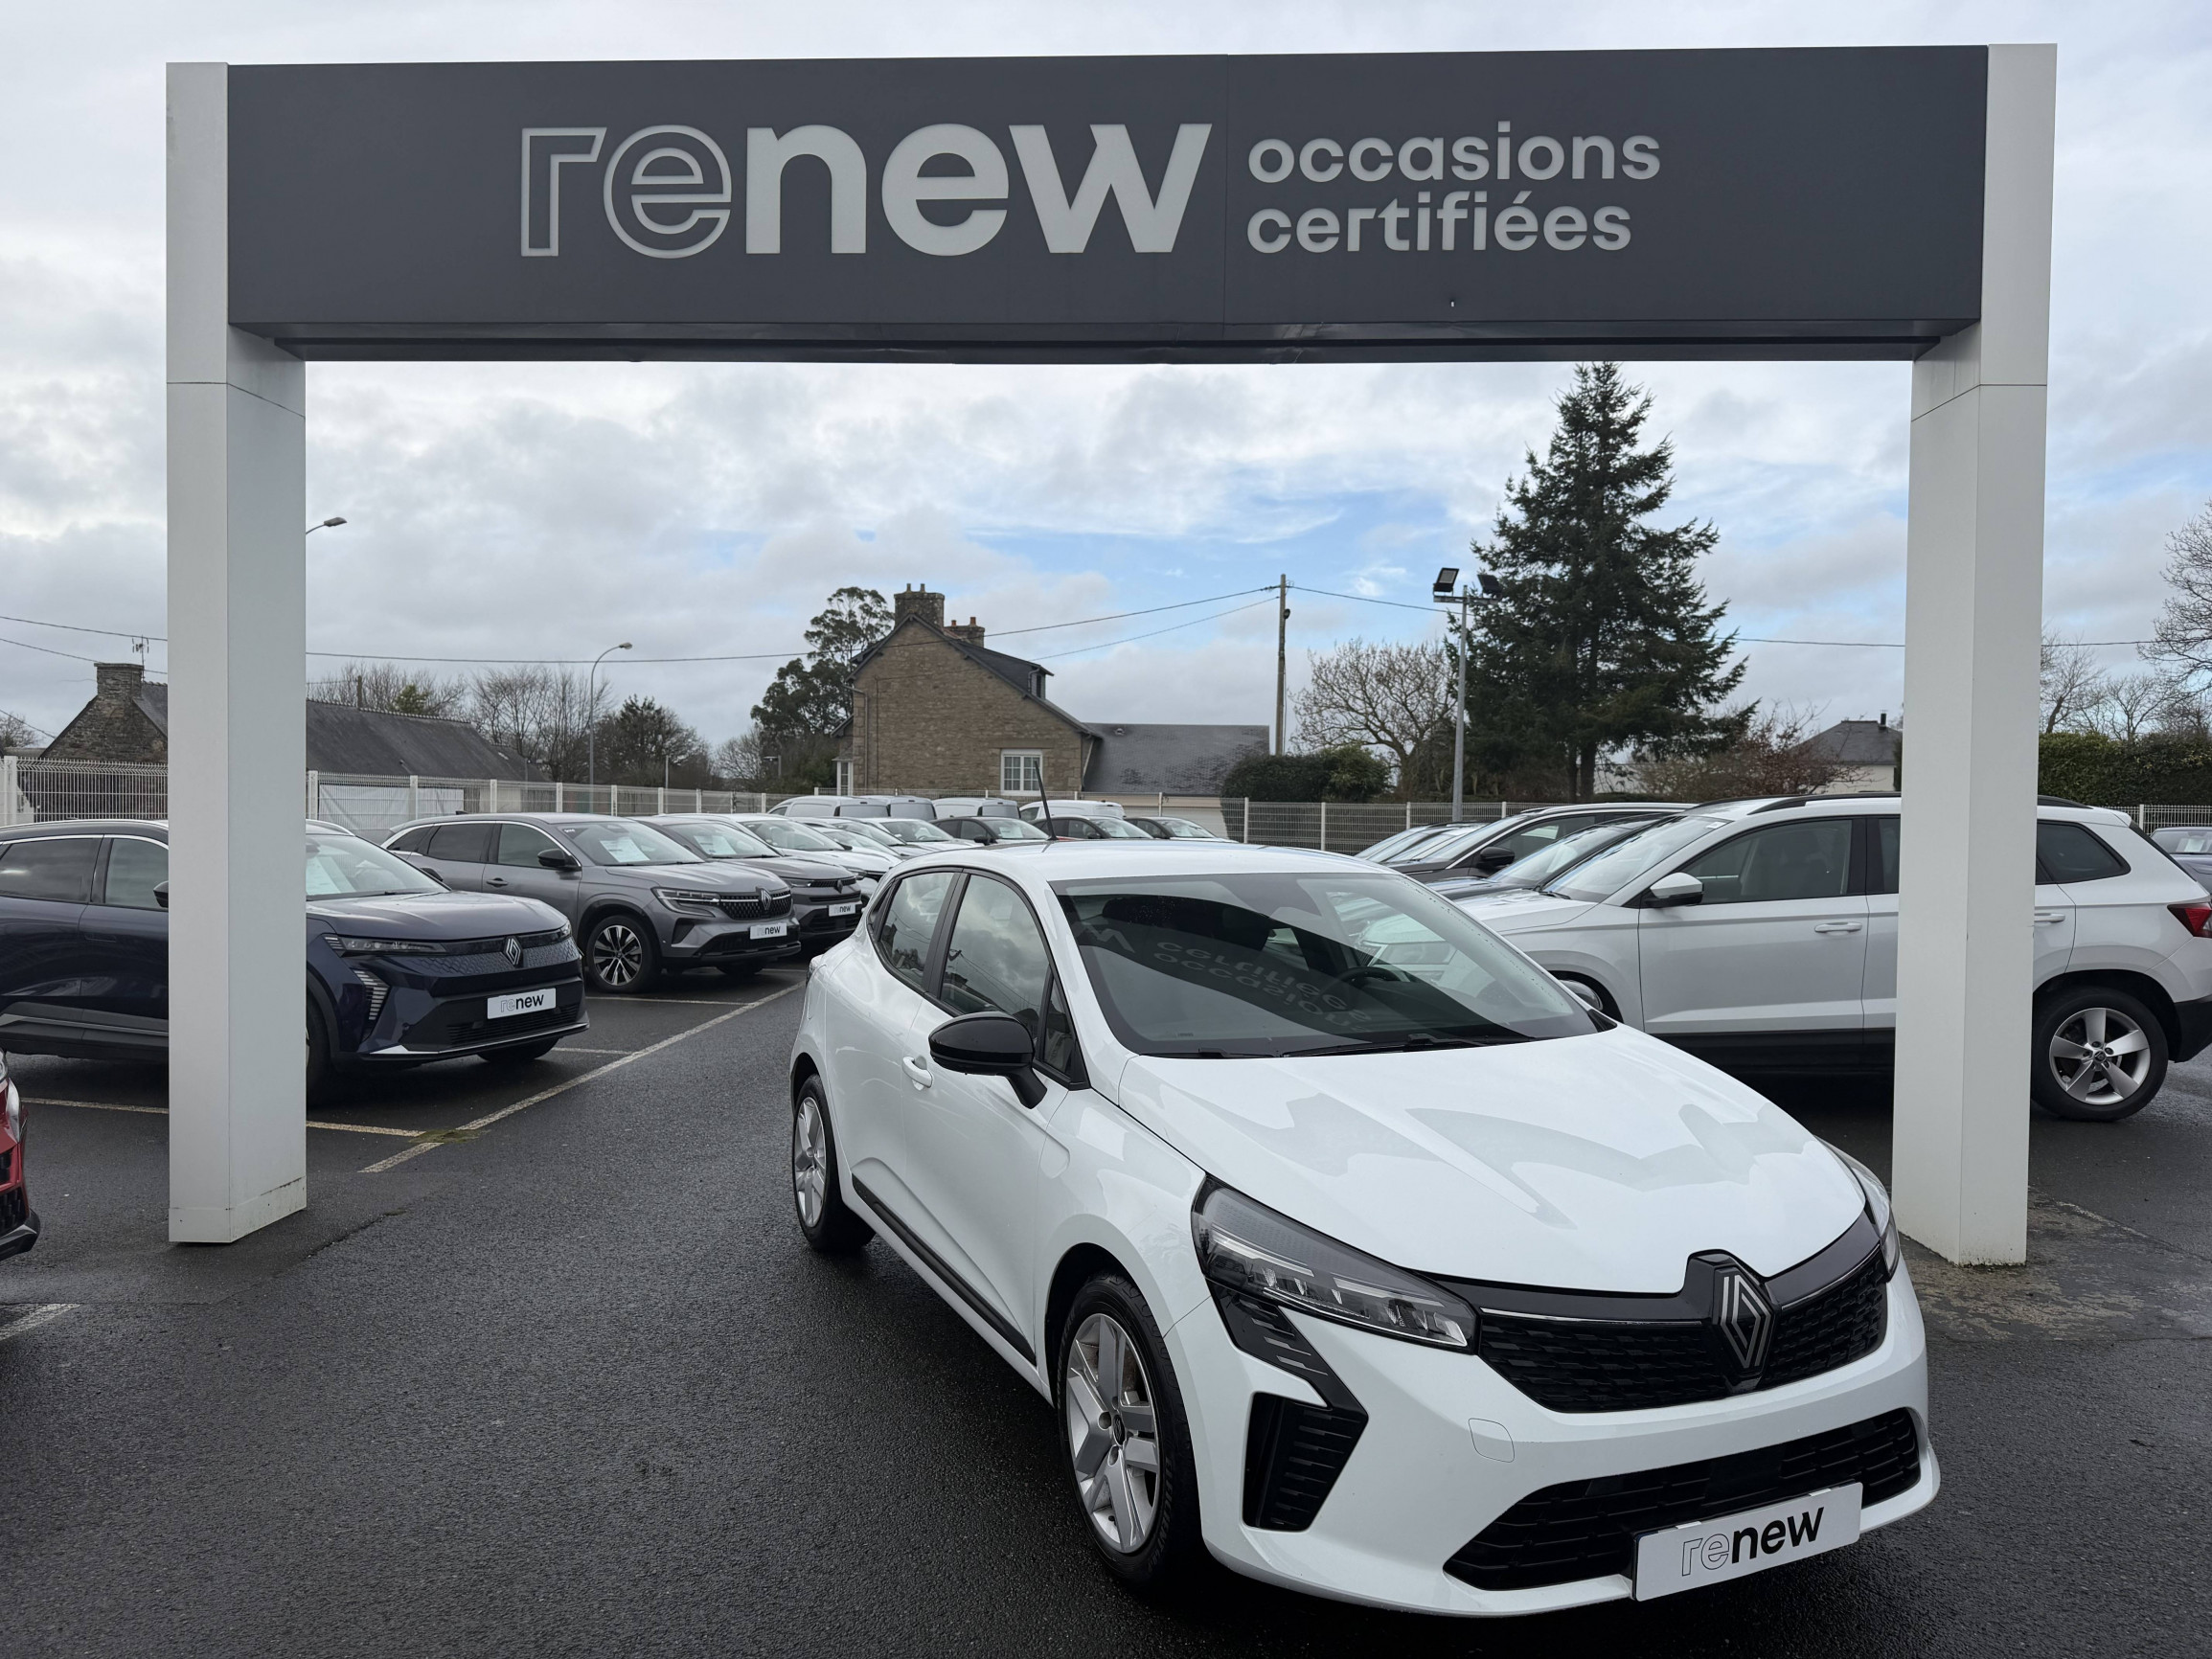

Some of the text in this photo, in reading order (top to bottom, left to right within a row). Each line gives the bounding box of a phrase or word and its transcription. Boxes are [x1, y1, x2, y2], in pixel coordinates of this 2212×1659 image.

[1247, 121, 1661, 183] occasions
[520, 123, 1213, 259] renew
[1246, 190, 1632, 254] certifiées
[500, 994, 544, 1012] renew
[1681, 1506, 1825, 1577] renew
